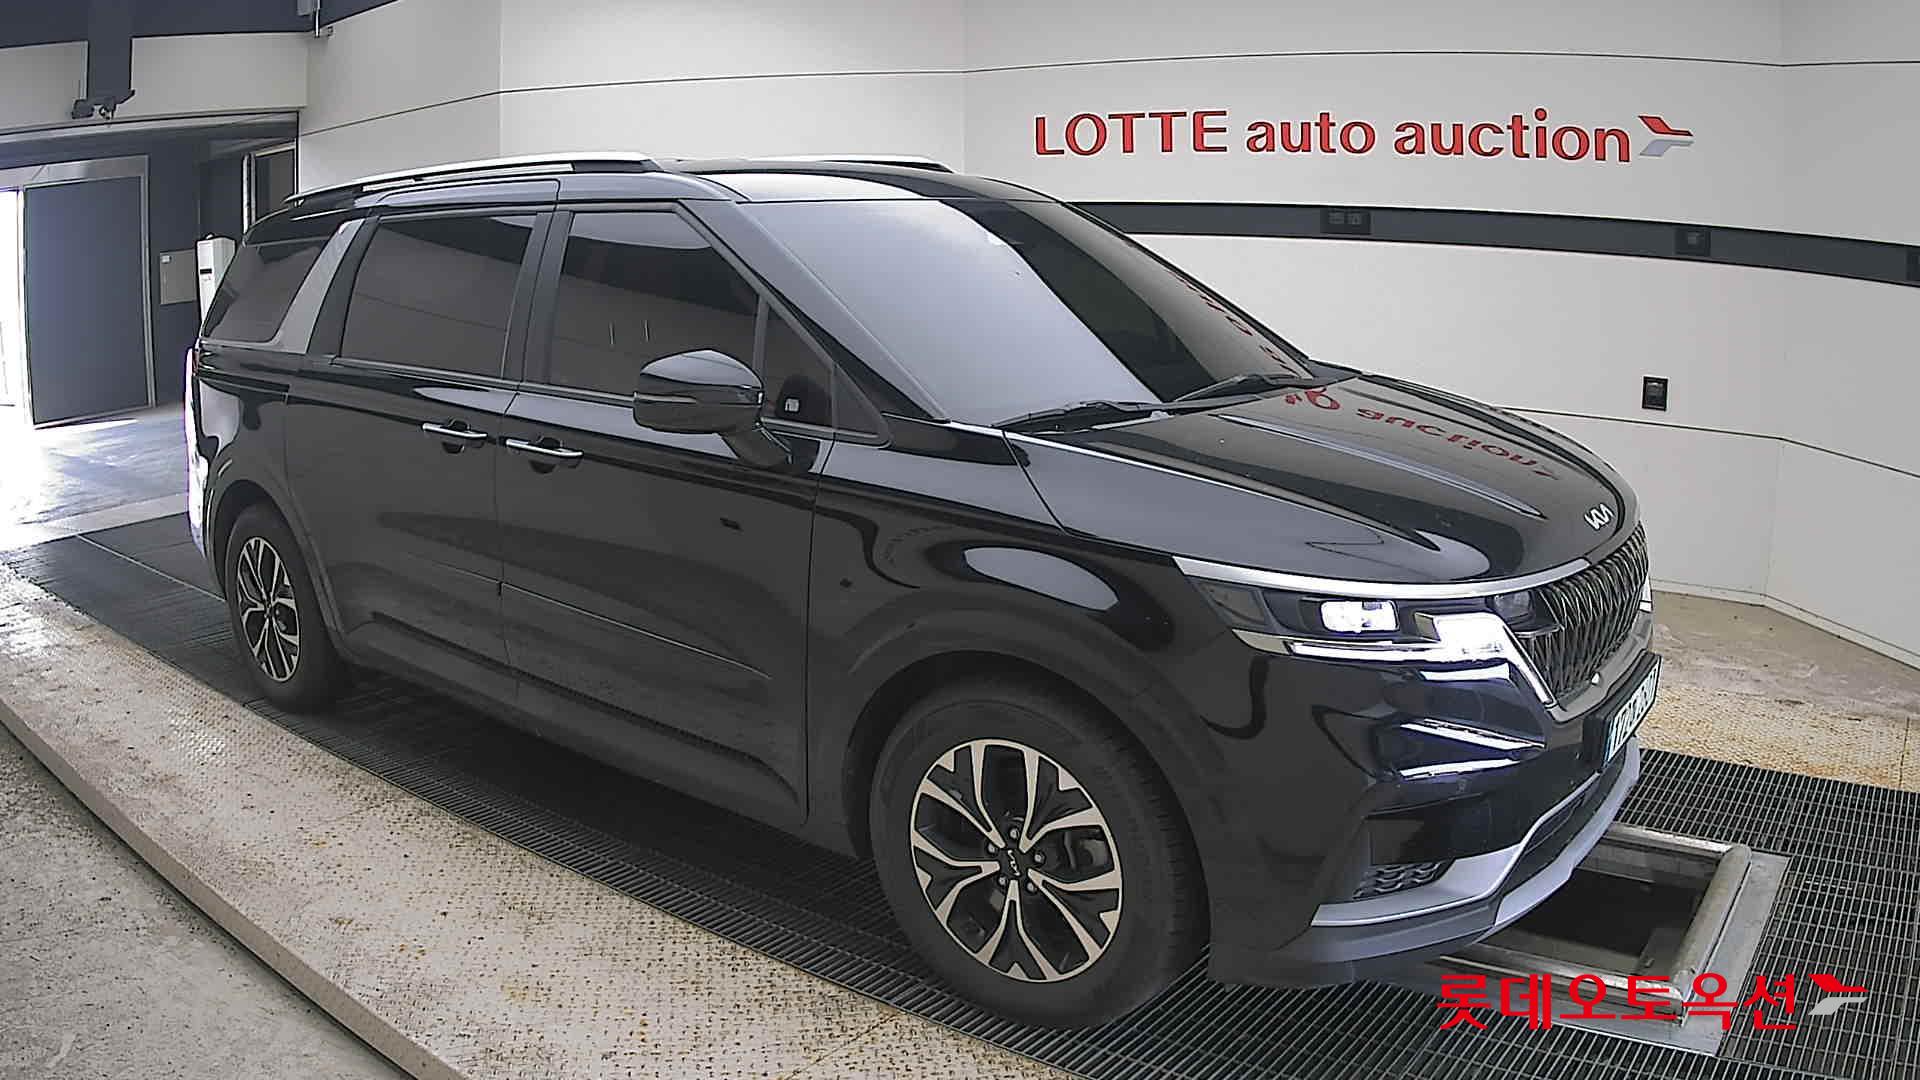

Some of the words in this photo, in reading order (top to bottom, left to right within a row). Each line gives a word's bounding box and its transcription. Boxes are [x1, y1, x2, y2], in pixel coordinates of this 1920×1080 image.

[1035, 111, 1228, 155] LOTTE
[1246, 112, 1376, 155] auto
[1393, 107, 1631, 163] auction
